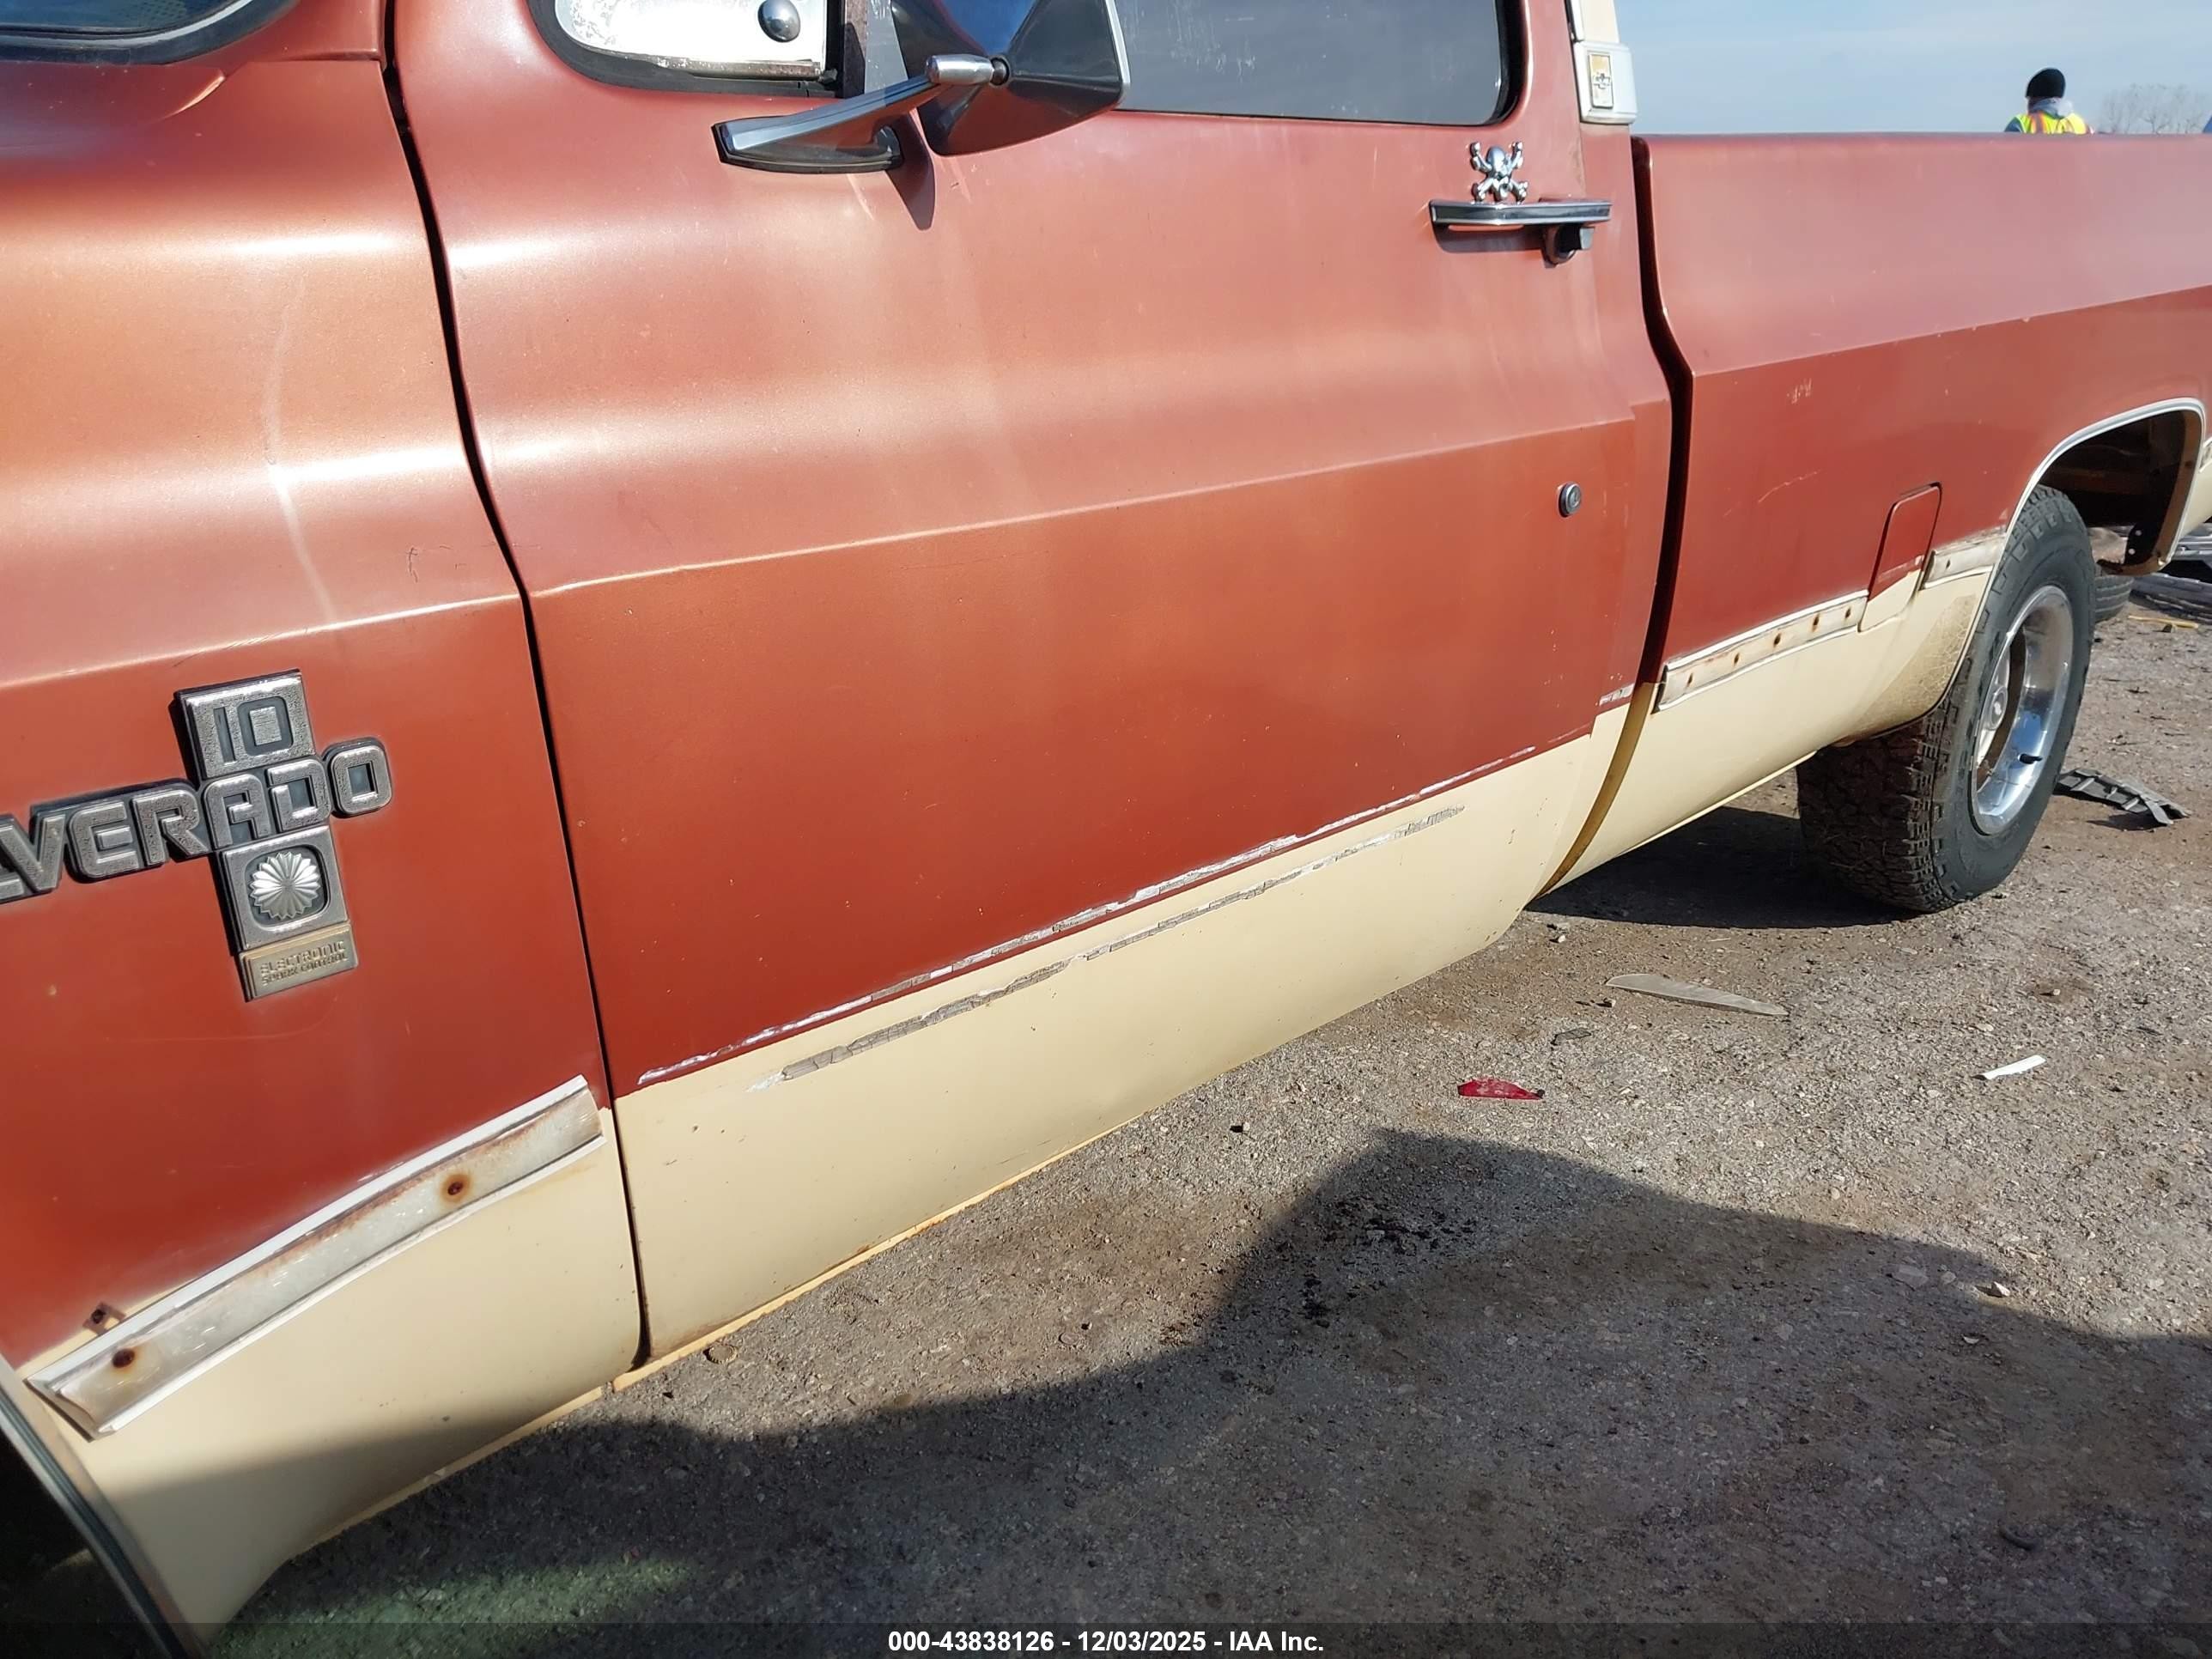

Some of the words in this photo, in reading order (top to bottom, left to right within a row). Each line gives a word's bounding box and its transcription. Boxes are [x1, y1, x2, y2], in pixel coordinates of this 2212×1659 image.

[212, 695, 294, 767] 10
[260, 940, 347, 975] ELECTRONIC
[301, 951, 348, 973] CONTROL
